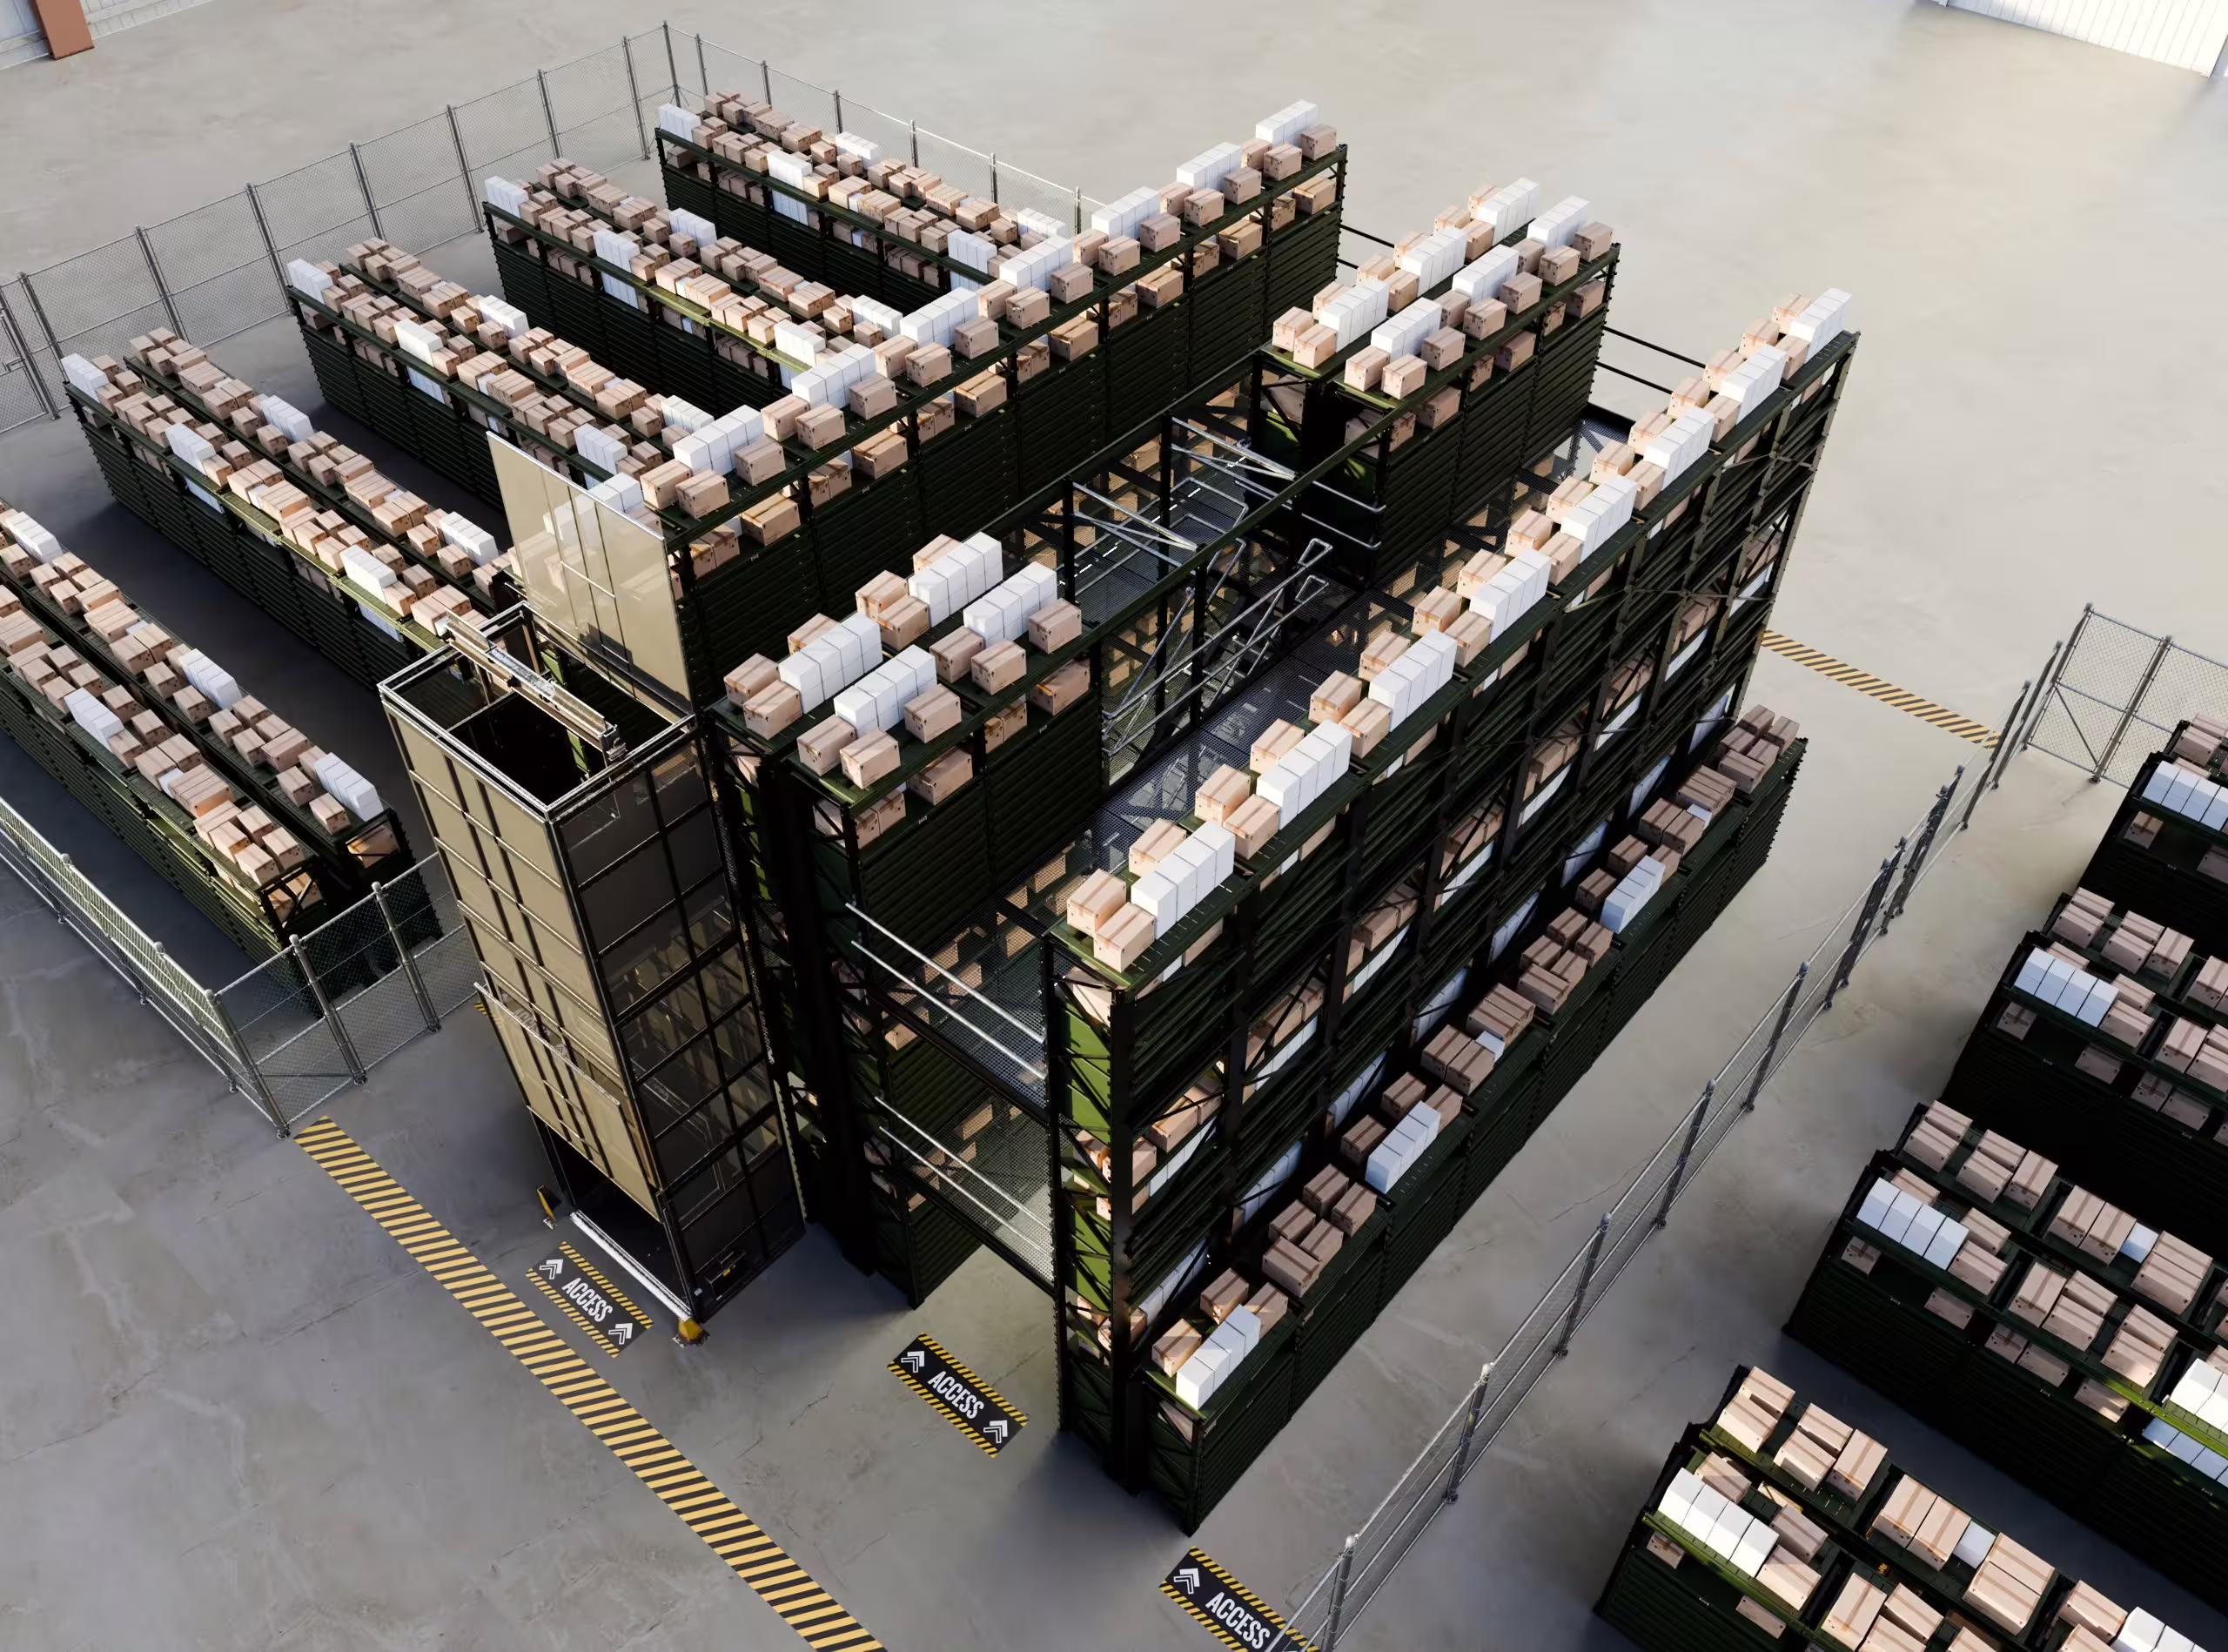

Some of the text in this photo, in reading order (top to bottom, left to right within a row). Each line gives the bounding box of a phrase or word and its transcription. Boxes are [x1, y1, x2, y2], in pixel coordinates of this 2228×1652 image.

[561, 1277, 613, 1322] ACCESS
[927, 1370, 984, 1419] ACCESS
[1205, 1591, 1271, 1649] ACCESS
